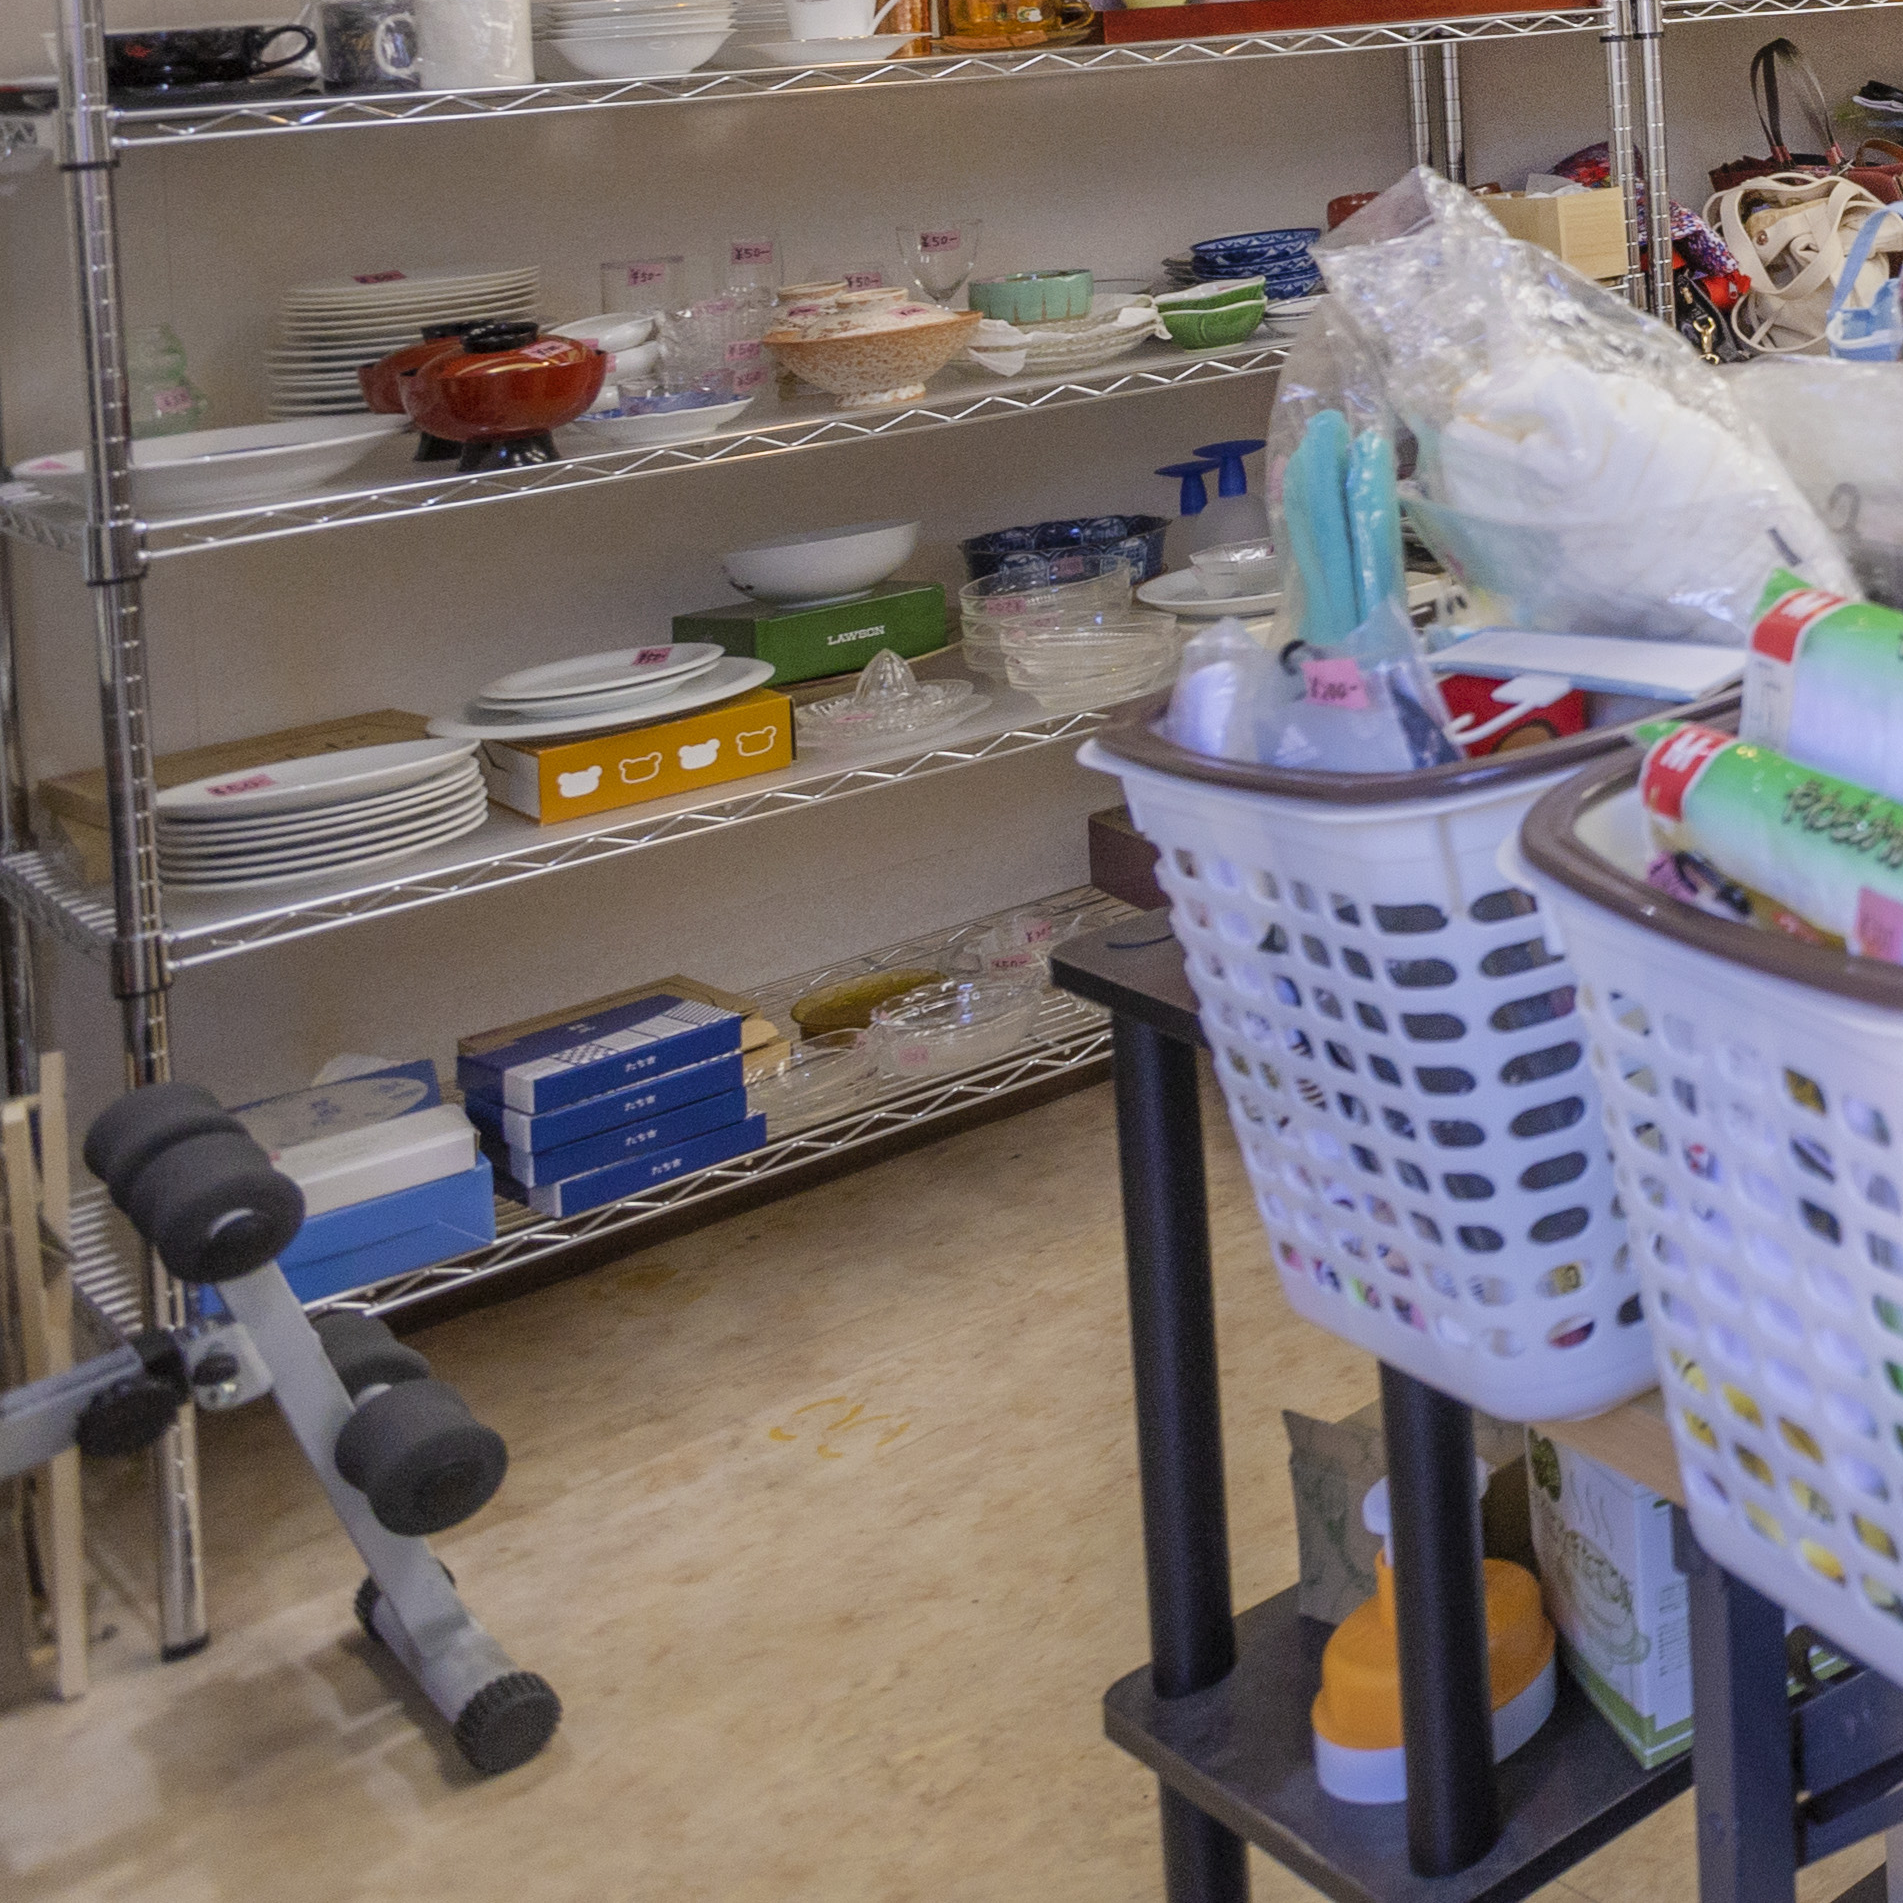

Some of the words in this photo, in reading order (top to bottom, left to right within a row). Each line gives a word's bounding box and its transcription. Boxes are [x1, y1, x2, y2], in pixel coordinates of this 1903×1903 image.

[920, 234, 958, 248] ¥50-
[827, 624, 886, 646] LAWSON
[623, 1055, 658, 1073] たち吉
[623, 1094, 657, 1112] たち吉
